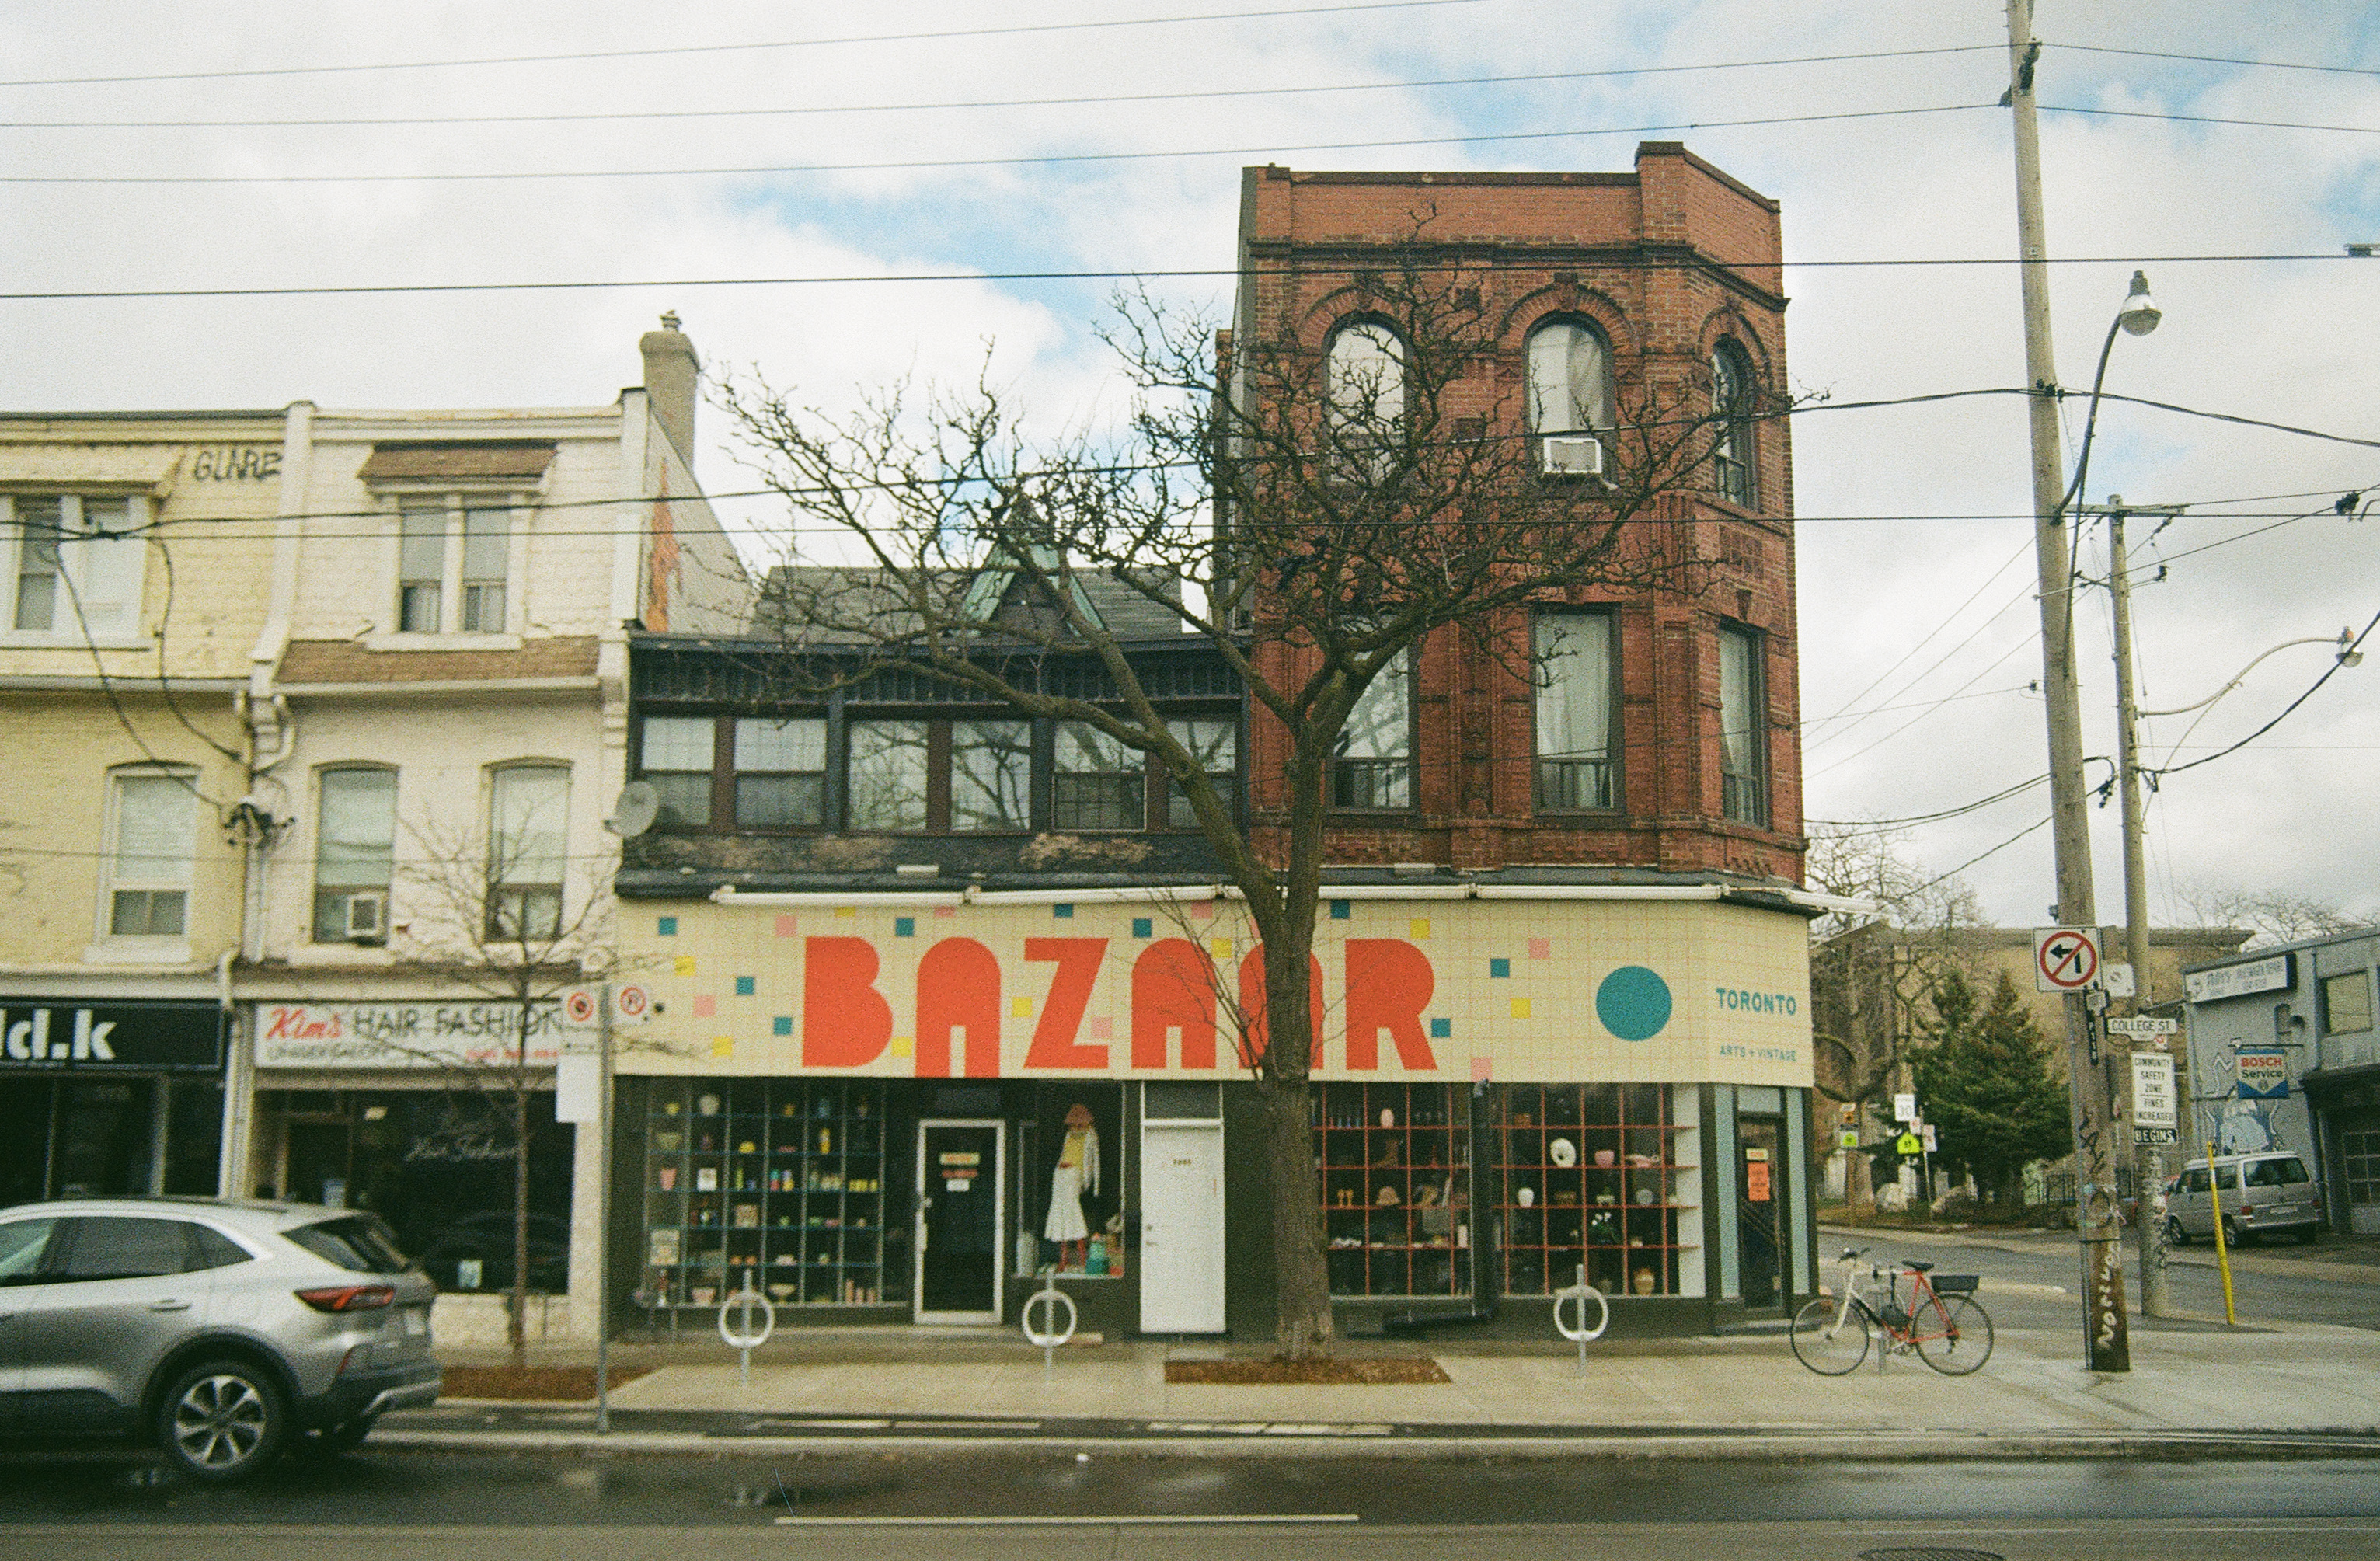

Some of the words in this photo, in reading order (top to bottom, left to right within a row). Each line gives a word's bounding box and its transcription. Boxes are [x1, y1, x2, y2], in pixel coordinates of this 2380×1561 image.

[1715, 988, 1796, 1016] TORONTO
[265, 1005, 343, 1040] Kim's
[354, 1007, 420, 1036] HAIR
[2111, 1020, 2155, 1033] COLLEGE
[0, 1009, 117, 1061] d.k
[1720, 1045, 1746, 1058] ARTS
[1757, 1047, 1796, 1062] VINTAGE
[2134, 1057, 2171, 1068] COMMUNITY
[2240, 1057, 2282, 1068] BOSCH
[2140, 1070, 2166, 1081] SAFETY
[2241, 1069, 2283, 1079] Service
[2145, 1083, 2163, 1093] ZONE
[2144, 1098, 2164, 1109] FINES
[2135, 1111, 2174, 1122] INCREASED
[2134, 1129, 2173, 1143] BEGINS
